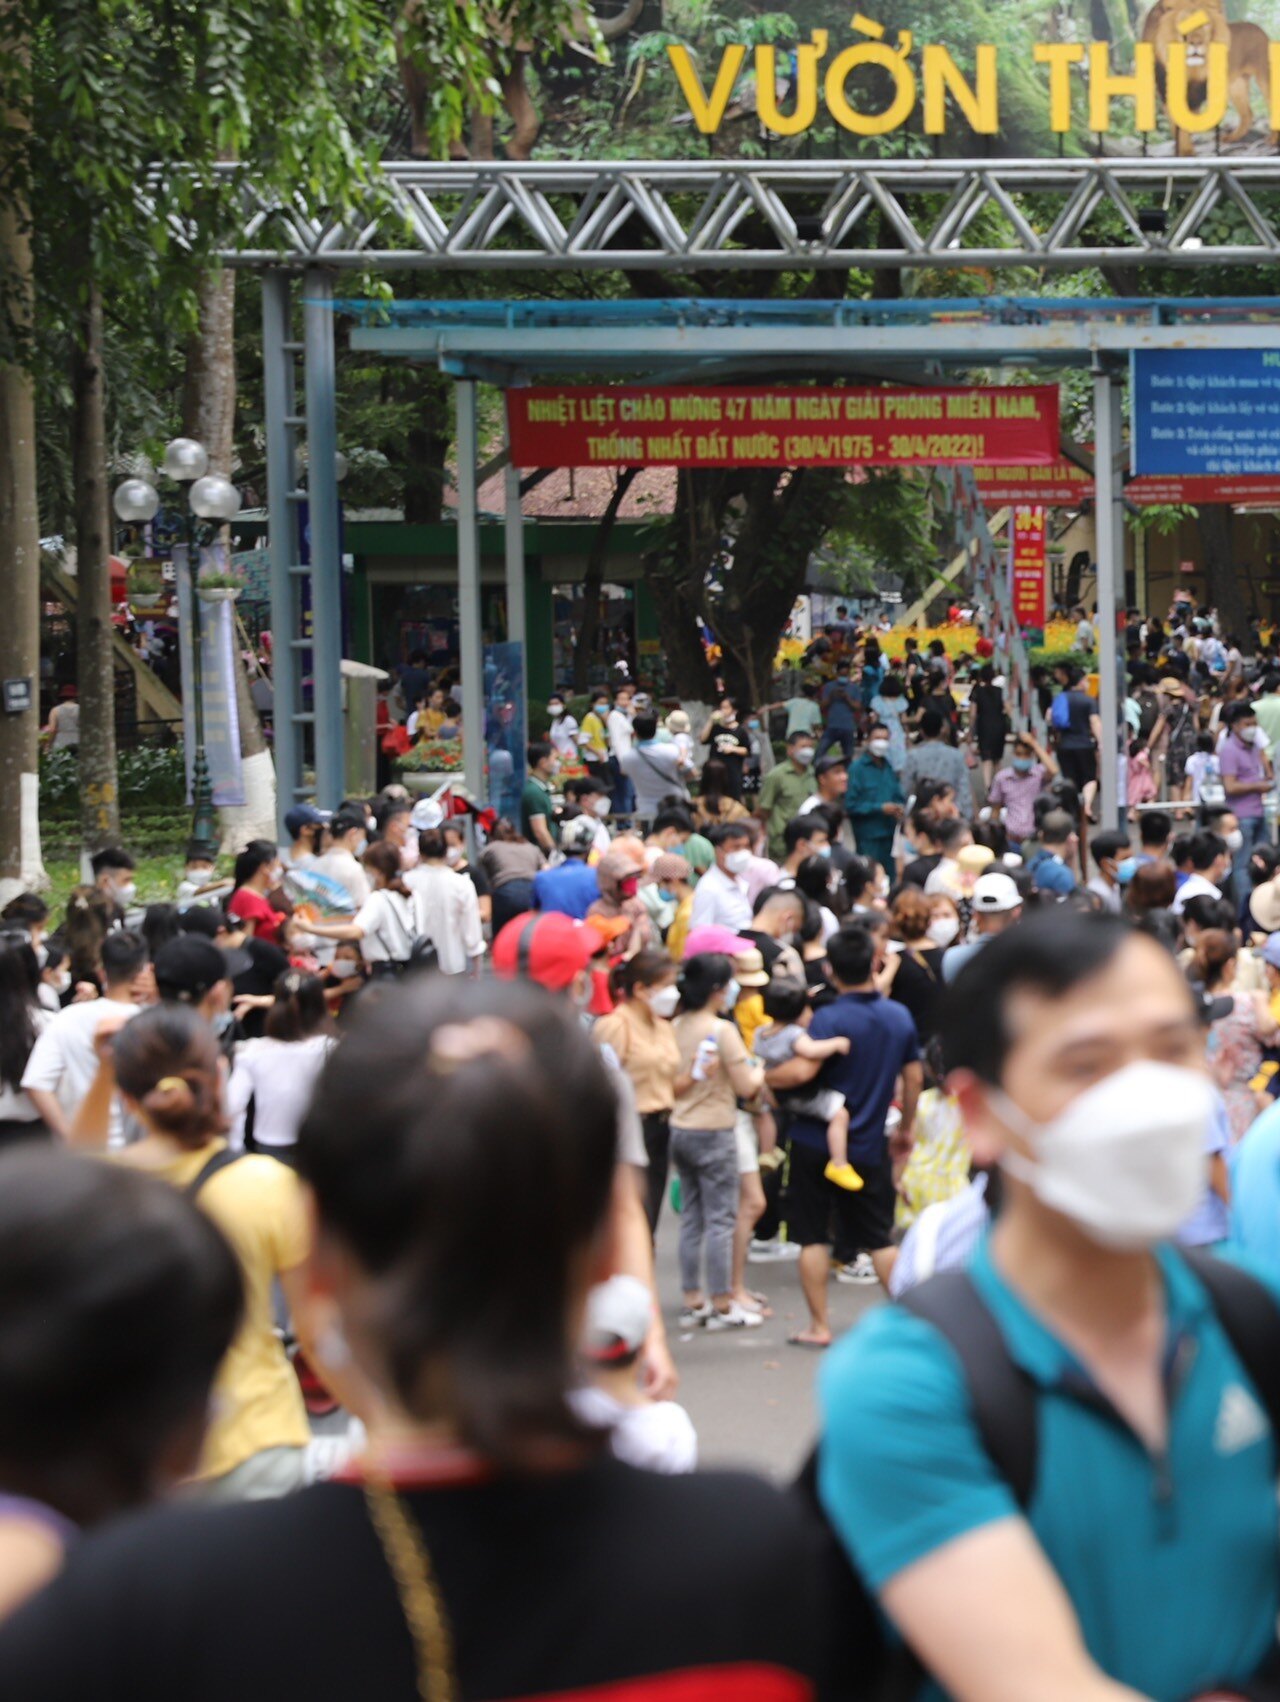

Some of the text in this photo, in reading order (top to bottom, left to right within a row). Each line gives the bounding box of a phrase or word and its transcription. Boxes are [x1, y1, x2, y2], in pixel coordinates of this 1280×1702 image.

[667, 13, 999, 136] VƯỜN
[1034, 10, 1228, 133] THÚ
[527, 389, 1041, 426] NHIỆT LIỆT CHÀO MỪNG 47 NĂM NGÀY GIẢI PHÓNG MIỀN NAM,
[587, 429, 644, 460] THỐNG
[647, 428, 693, 460] NHẤT
[696, 428, 729, 459] ĐẤT
[732, 431, 780, 459] NƯỚC
[784, 434, 873, 460] (30/4/1975
[888, 433, 985, 460] 30/4/2022)!
